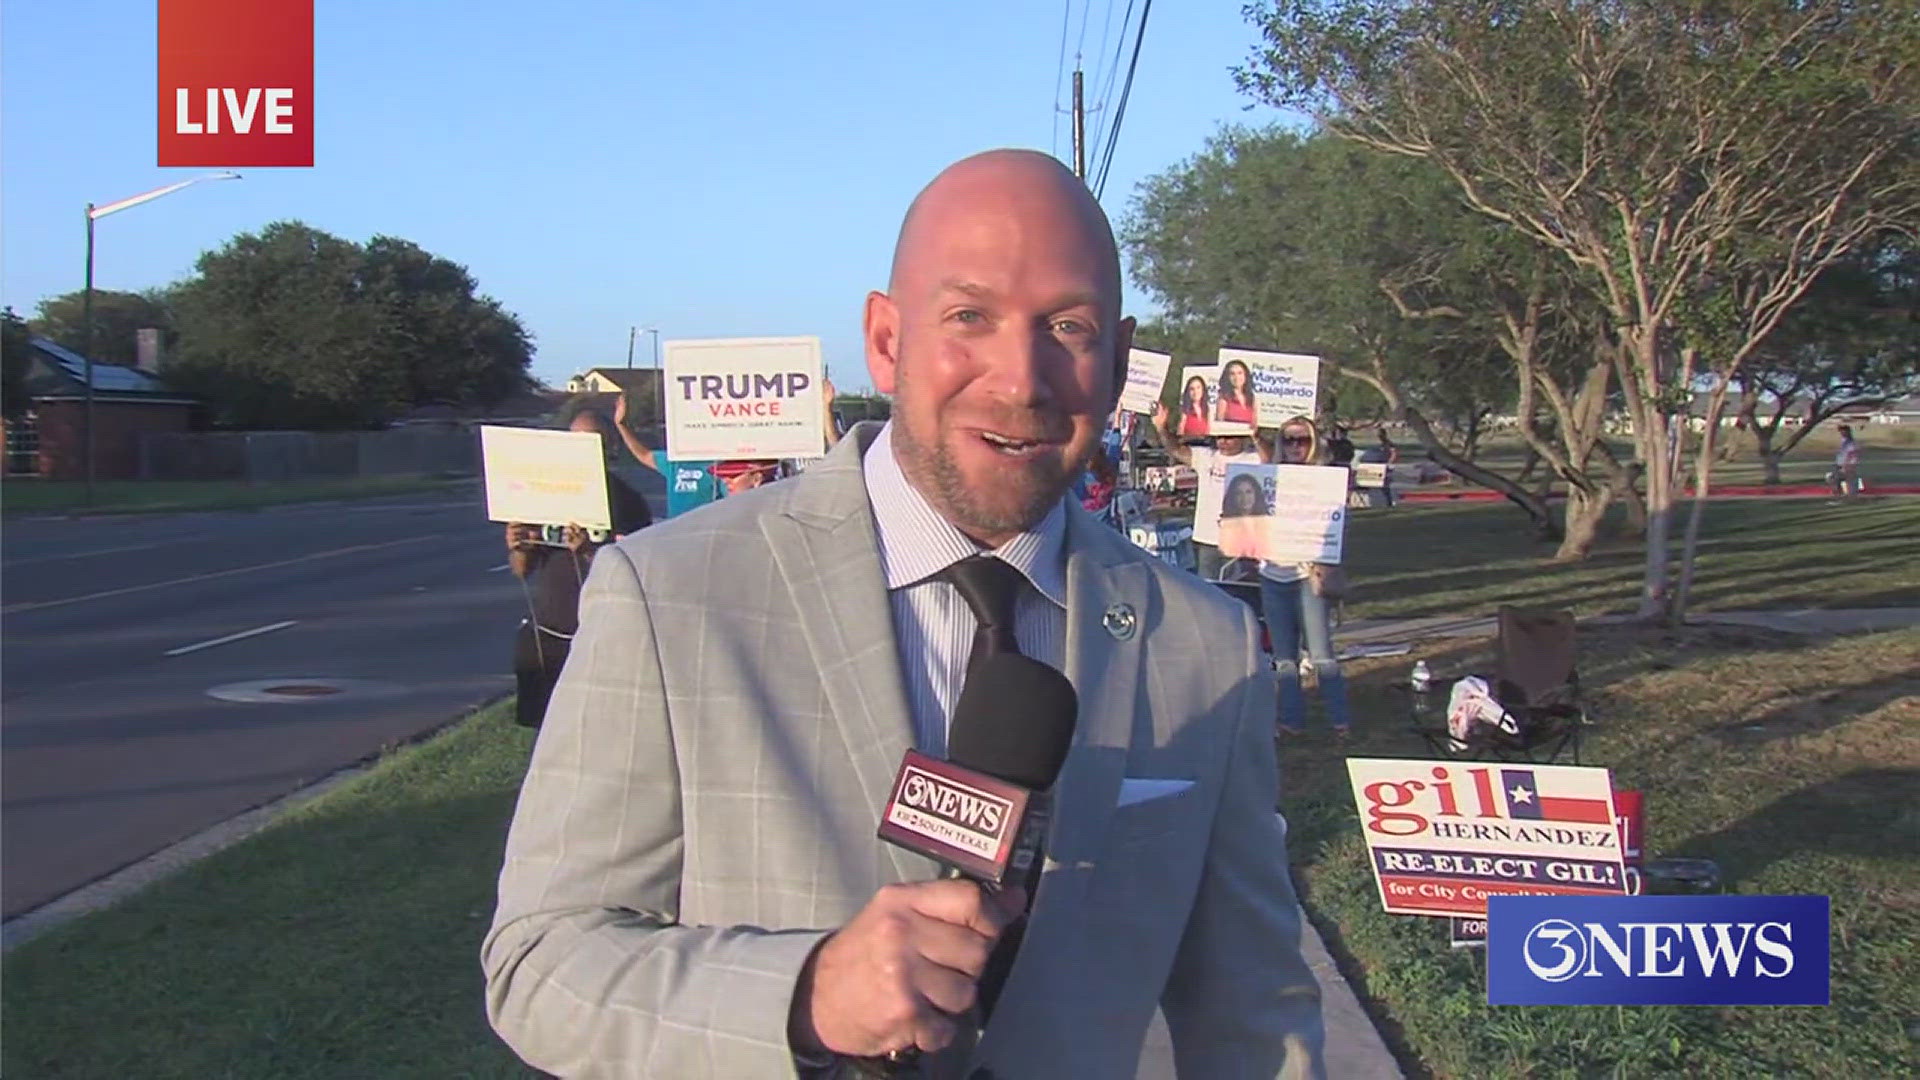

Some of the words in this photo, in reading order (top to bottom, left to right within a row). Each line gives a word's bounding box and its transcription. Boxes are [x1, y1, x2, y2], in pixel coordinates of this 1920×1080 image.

[676, 373, 810, 400] TRUMP
[1250, 371, 1292, 386] Mayor
[1251, 383, 1314, 398] Guajardo
[708, 402, 781, 417] VANCE
[1130, 528, 1179, 550] DAVID
[1364, 766, 1503, 836] gil
[918, 818, 953, 836] SOUTH
[956, 832, 989, 852] TEXAS
[1432, 821, 1616, 849] HERNANDEZ
[1383, 851, 1537, 879] RE-ELECT
[1546, 860, 1617, 885] GIL!
[1388, 882, 1415, 896] for
[1419, 883, 1457, 901] City
[1462, 920, 1488, 934] FOR
